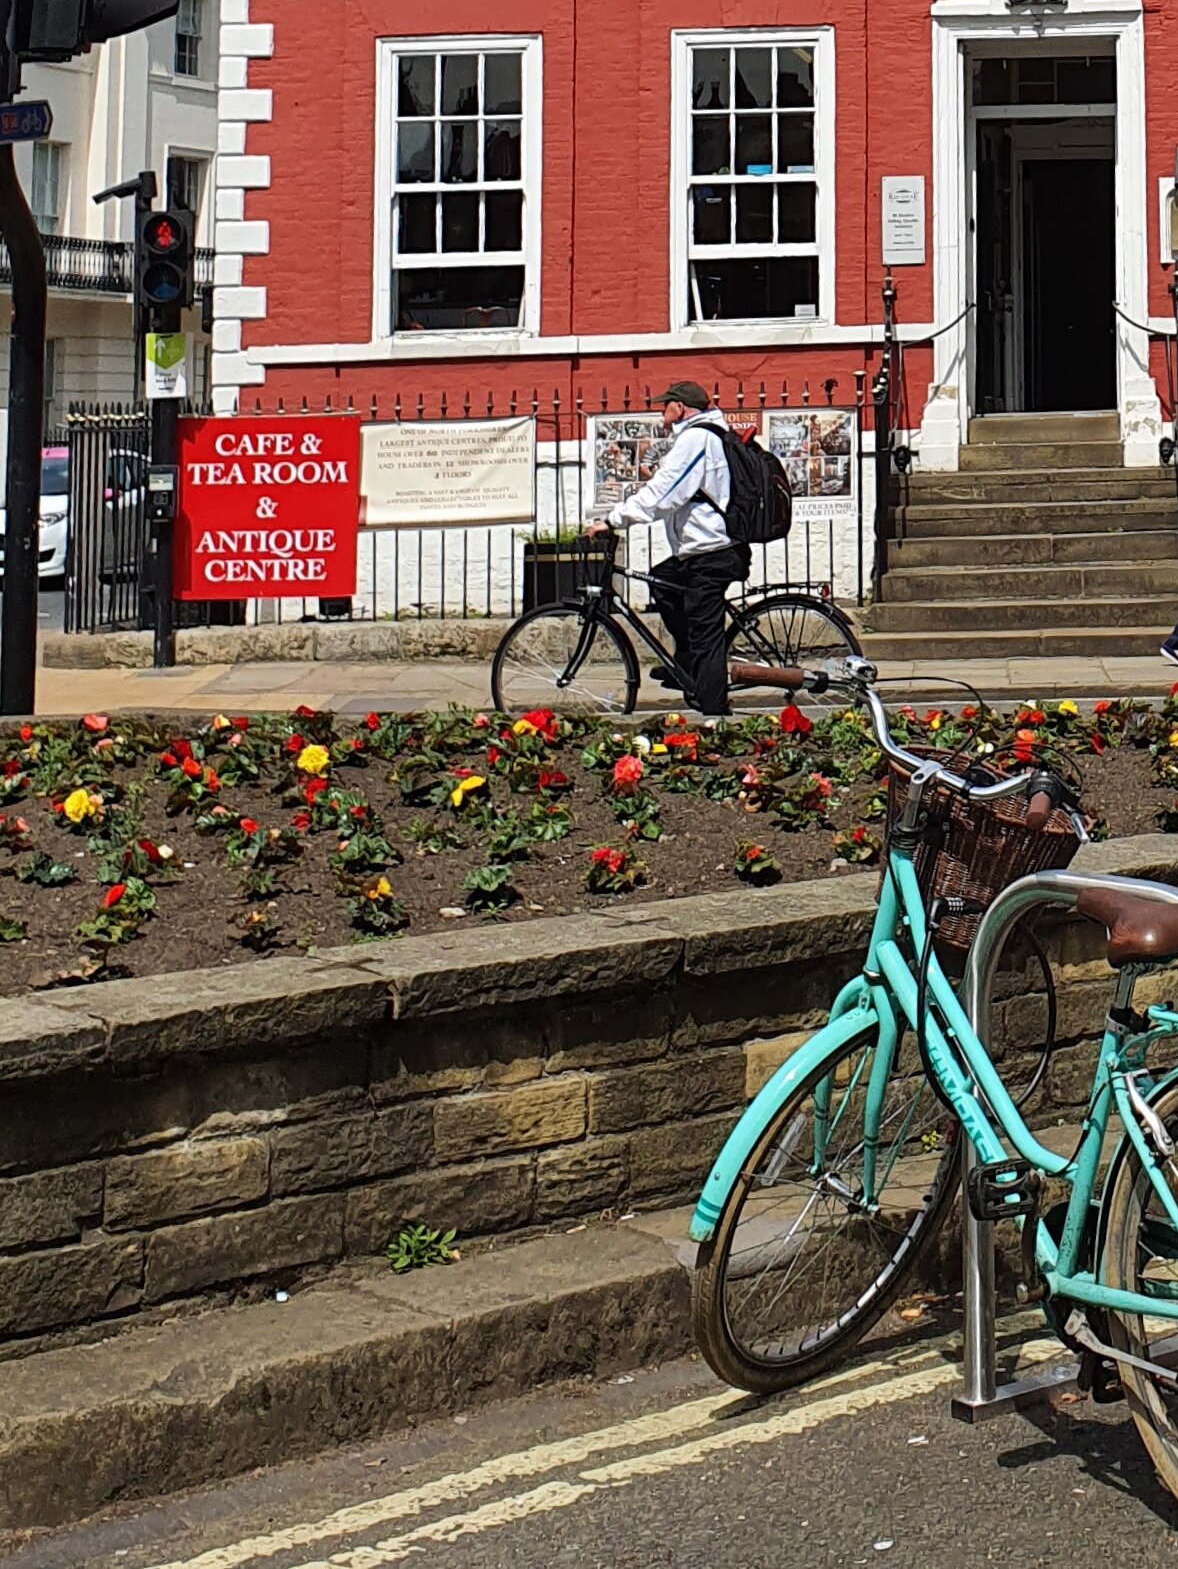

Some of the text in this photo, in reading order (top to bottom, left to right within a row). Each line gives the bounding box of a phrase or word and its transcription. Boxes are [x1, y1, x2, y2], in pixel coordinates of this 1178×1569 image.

[215, 433, 322, 456] CAFE &
[187, 461, 349, 485] TEA ROOM
[256, 496, 278, 518] &
[195, 529, 336, 558] ANTIQUE
[204, 558, 327, 582] CENTRE
